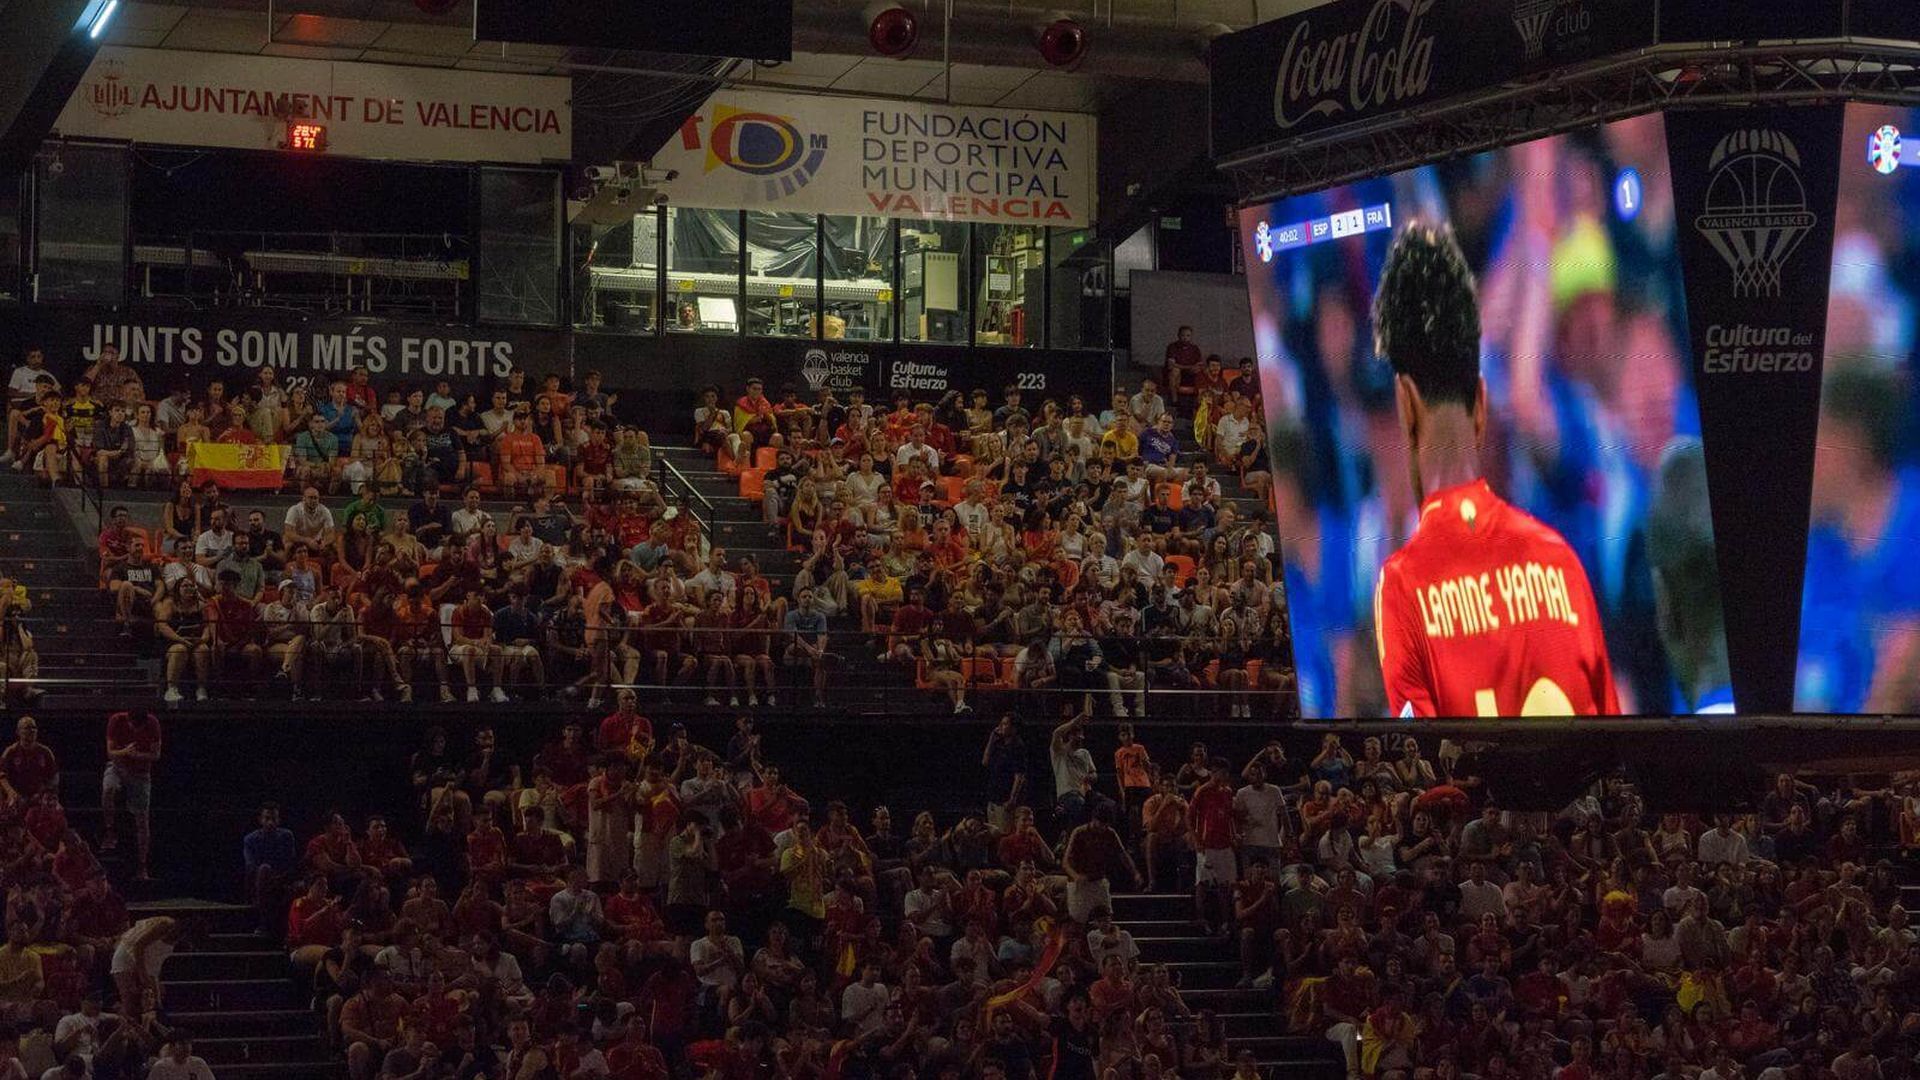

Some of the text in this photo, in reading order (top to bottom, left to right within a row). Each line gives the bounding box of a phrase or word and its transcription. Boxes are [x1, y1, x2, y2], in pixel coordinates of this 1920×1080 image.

[1556, 2, 1591, 36] club
[1274, 0, 1435, 129] Coca-Cola
[140, 84, 561, 135] AJUNTAMENT DE VALENCIA
[863, 111, 1066, 144] FUNDACIÓN
[863, 138, 1068, 171] DEPORTIVA
[862, 165, 1069, 199] MUNICIPAL
[1622, 179, 1633, 208] 1
[867, 192, 1072, 220] VALENCIA
[1312, 222, 1329, 237] ESP
[1353, 215, 1358, 228] 1
[1366, 210, 1384, 225] FRA
[1703, 214, 1810, 229] VALENCIA BASKET
[1706, 323, 1813, 348] Cultura del
[82, 324, 514, 378] JUNTS SOM MÉS FORTS
[830, 350, 869, 364] valencia
[1703, 349, 1813, 374] Esfuerzo
[830, 363, 863, 376] basket
[892, 360, 936, 376] Cultura
[1017, 372, 1046, 390] 223
[830, 376, 853, 388] club
[890, 374, 948, 390] Esfuerzo
[1416, 560, 1579, 638] LAMINE YAMAL
